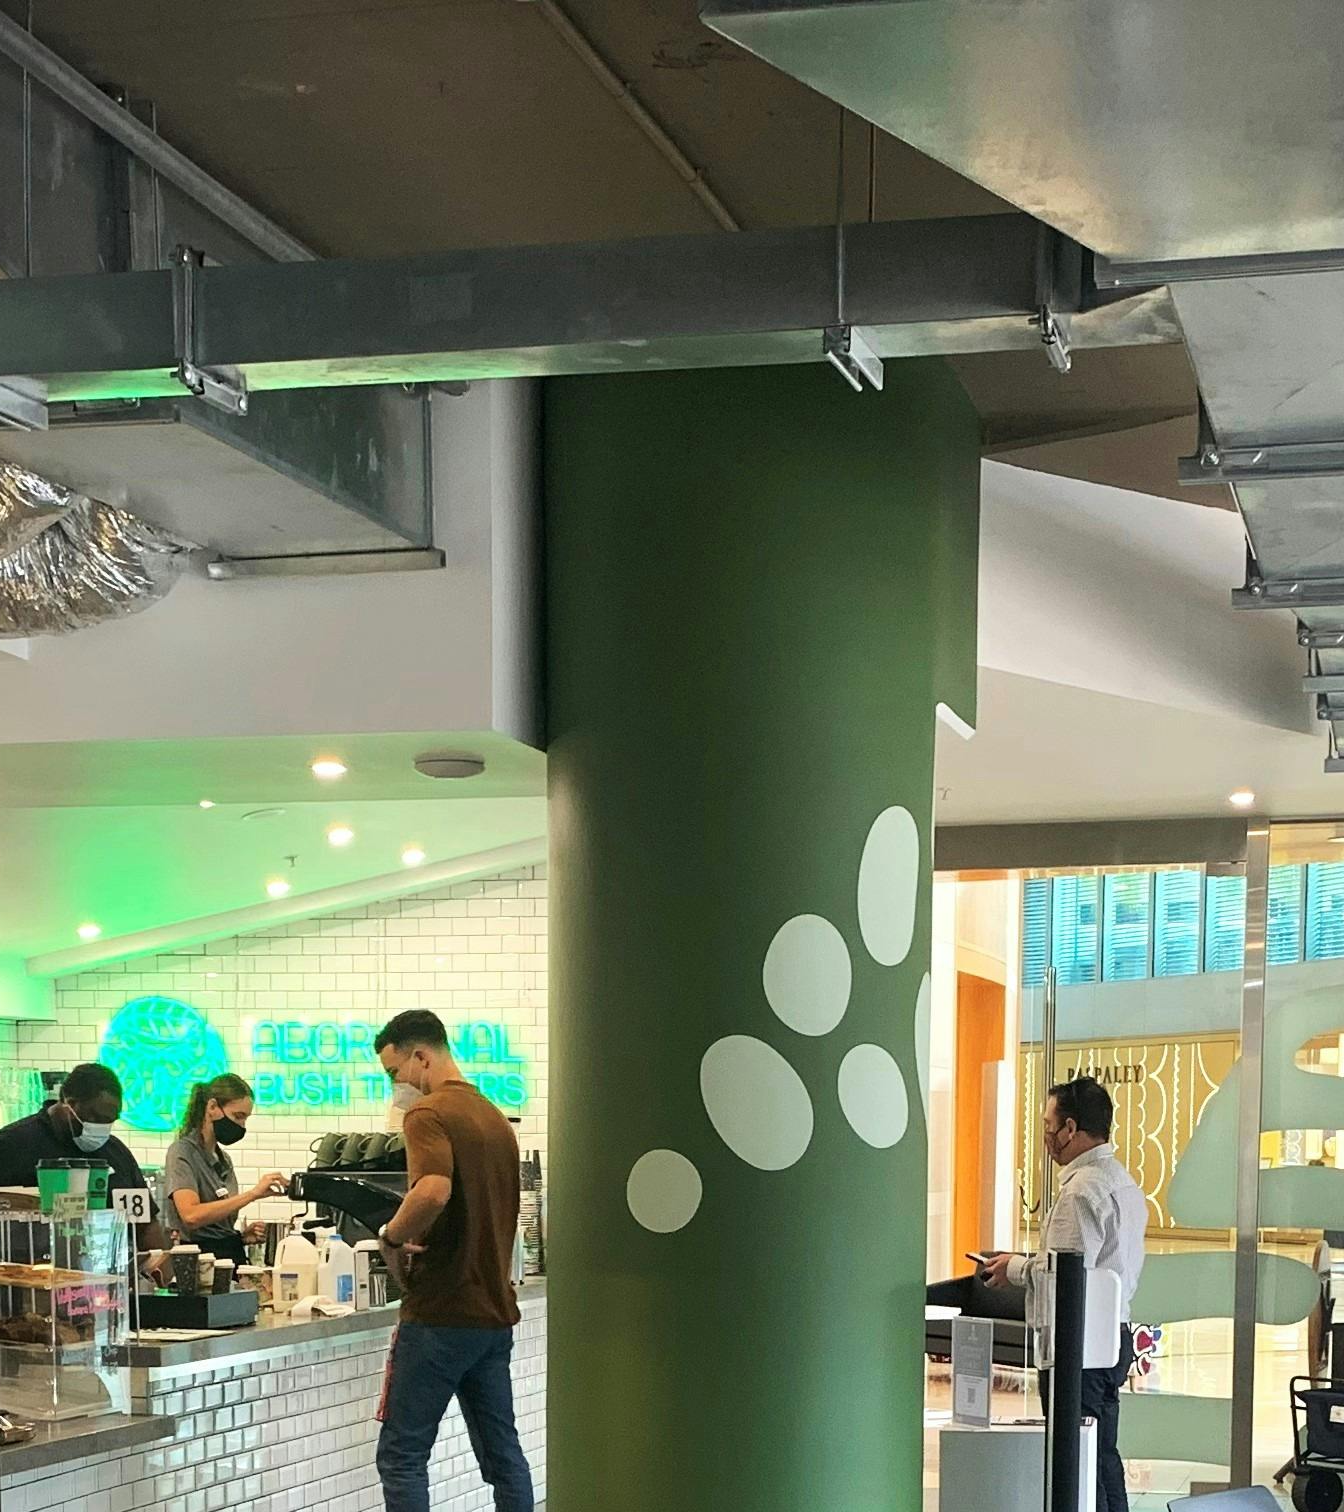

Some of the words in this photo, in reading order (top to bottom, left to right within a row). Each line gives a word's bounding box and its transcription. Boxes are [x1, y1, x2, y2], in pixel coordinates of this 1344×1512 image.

[252, 1020, 528, 1064] ABORNAL
[254, 1072, 350, 1106] BUSH
[119, 1194, 145, 1217] 18
